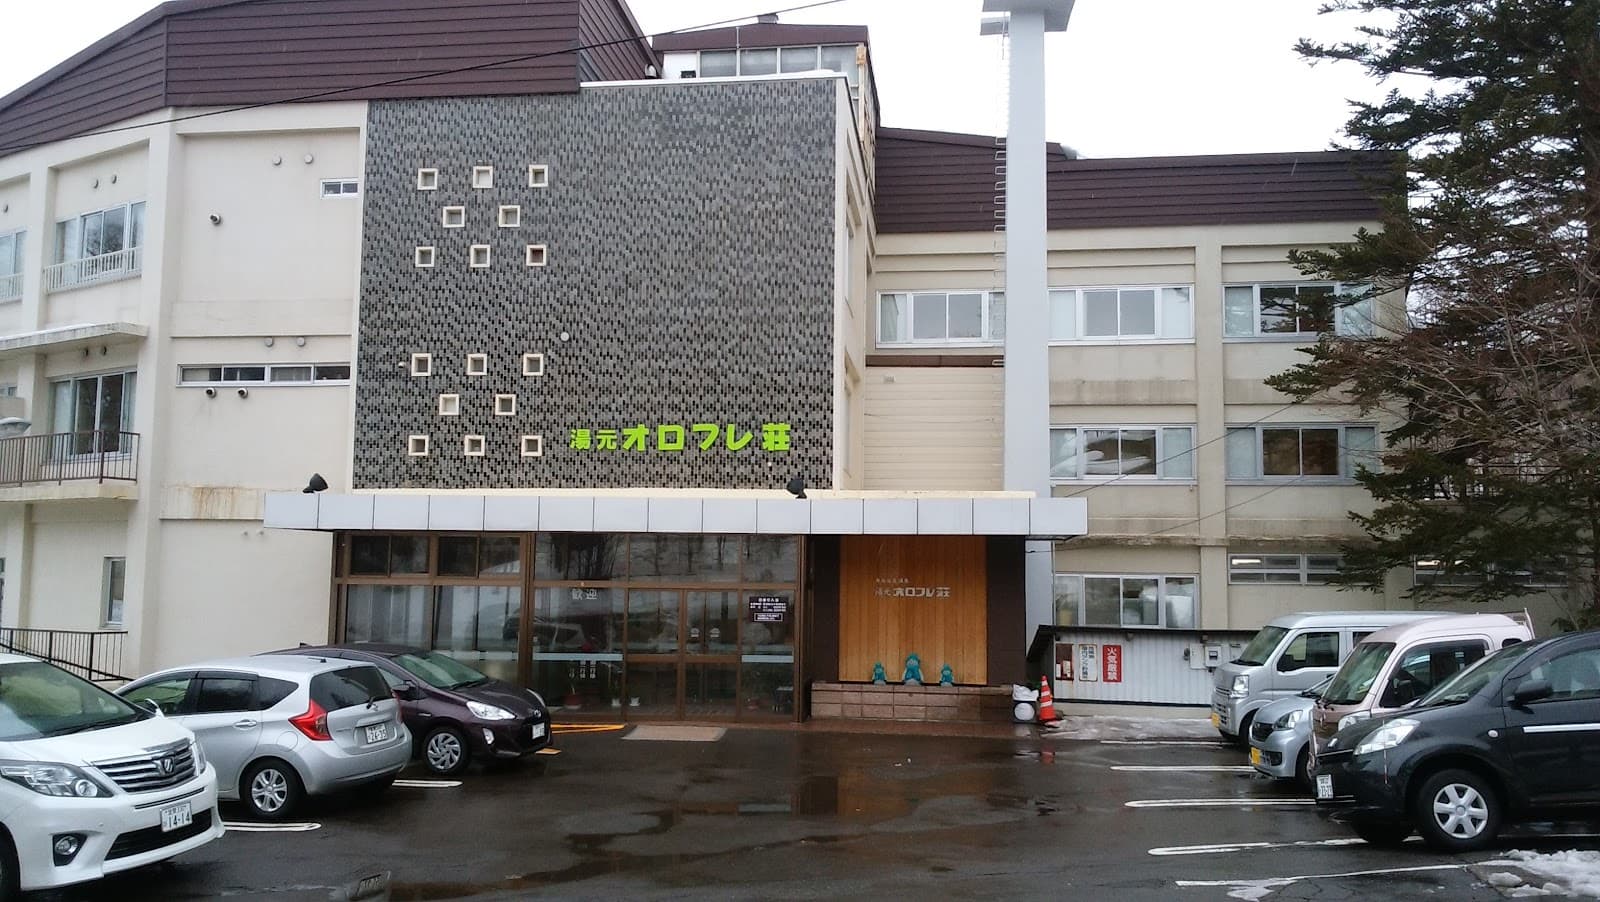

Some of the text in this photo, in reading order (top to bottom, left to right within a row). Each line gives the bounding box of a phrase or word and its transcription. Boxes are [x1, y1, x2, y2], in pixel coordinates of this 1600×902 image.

[570, 424, 791, 451] 湯元オロフレ荘
[571, 588, 598, 600] 歓迎
[1107, 647, 1118, 680] 火気厳禁
